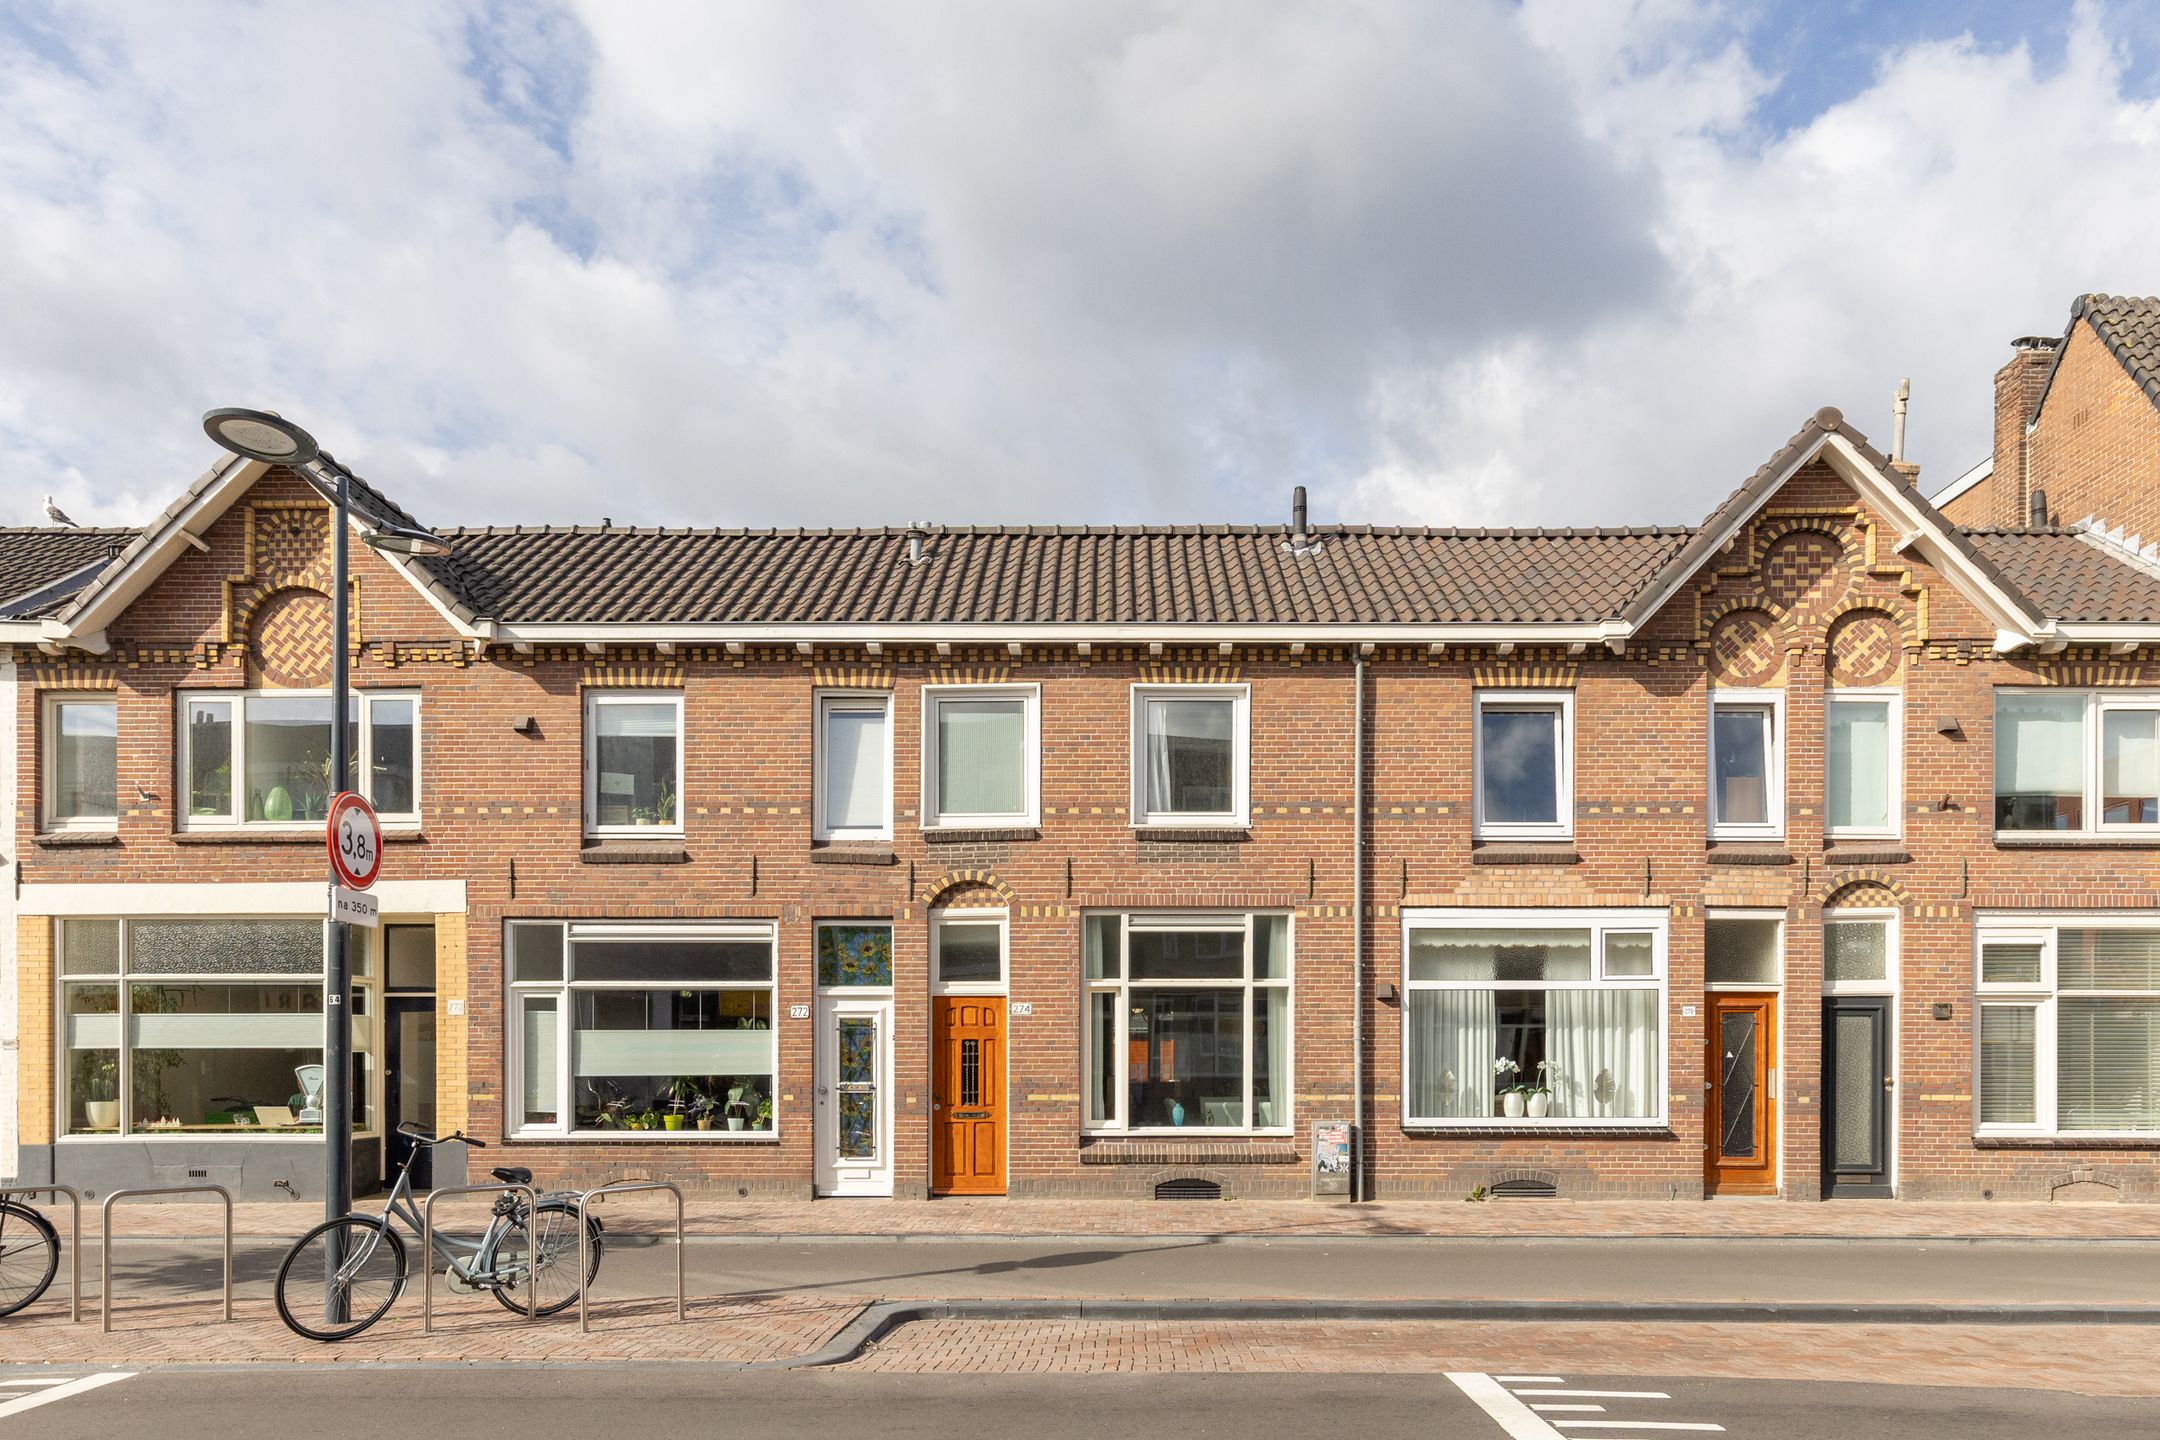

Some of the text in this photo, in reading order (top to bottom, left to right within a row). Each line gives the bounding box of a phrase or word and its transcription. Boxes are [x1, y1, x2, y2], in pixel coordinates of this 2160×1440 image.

[338, 900, 377, 917] na 350 m
[330, 995, 340, 1004] 64
[792, 1006, 808, 1017] 272
[1013, 1004, 1030, 1014] 274
